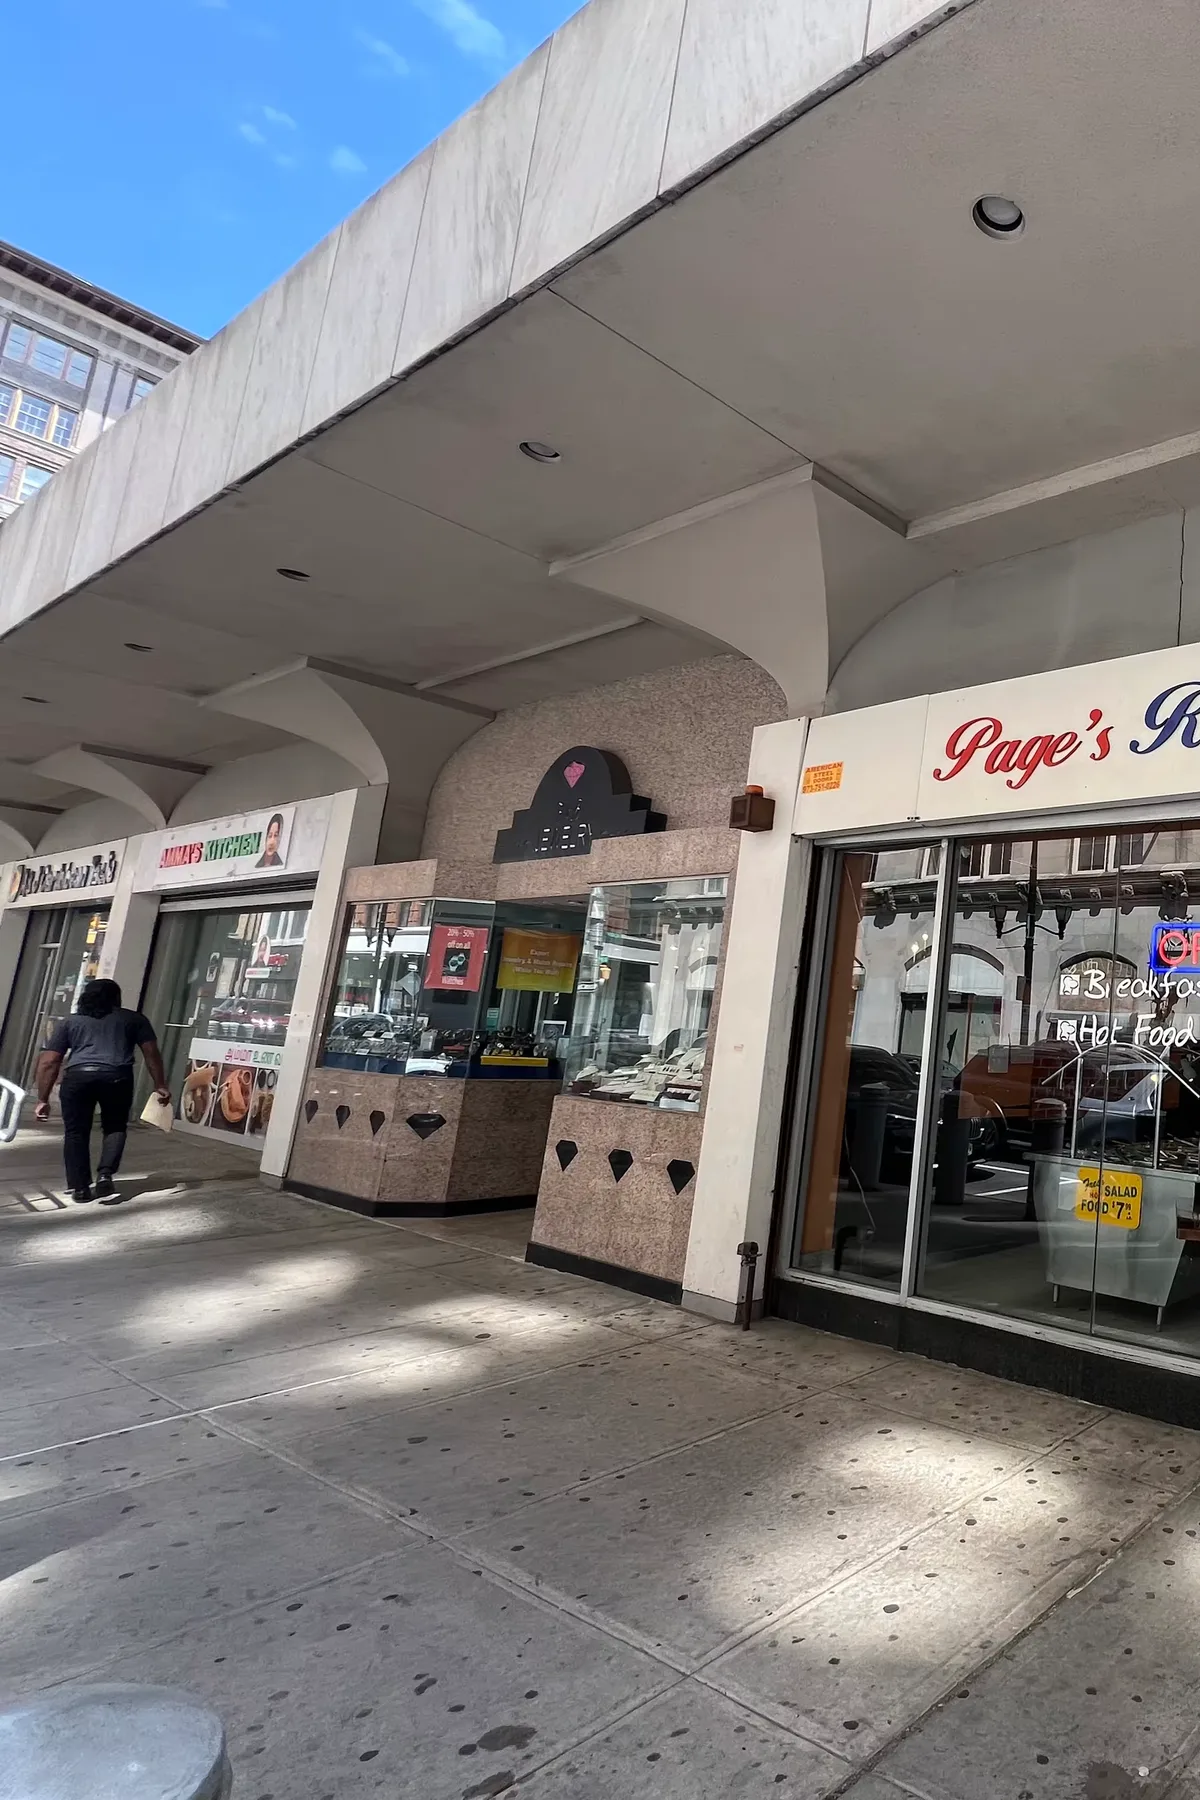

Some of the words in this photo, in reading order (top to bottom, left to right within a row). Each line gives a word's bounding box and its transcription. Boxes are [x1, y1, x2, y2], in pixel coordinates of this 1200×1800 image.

[932, 708, 1115, 790] Page's
[805, 762, 843, 773] AMERICAN
[160, 842, 203, 868] AMMA'S
[203, 832, 262, 861] KITCHEN
[1080, 1014, 1123, 1048] Hot
[1134, 1014, 1198, 1047] Food
[1104, 1185, 1138, 1198] SALAD
[1081, 1200, 1108, 1214] FOOD
